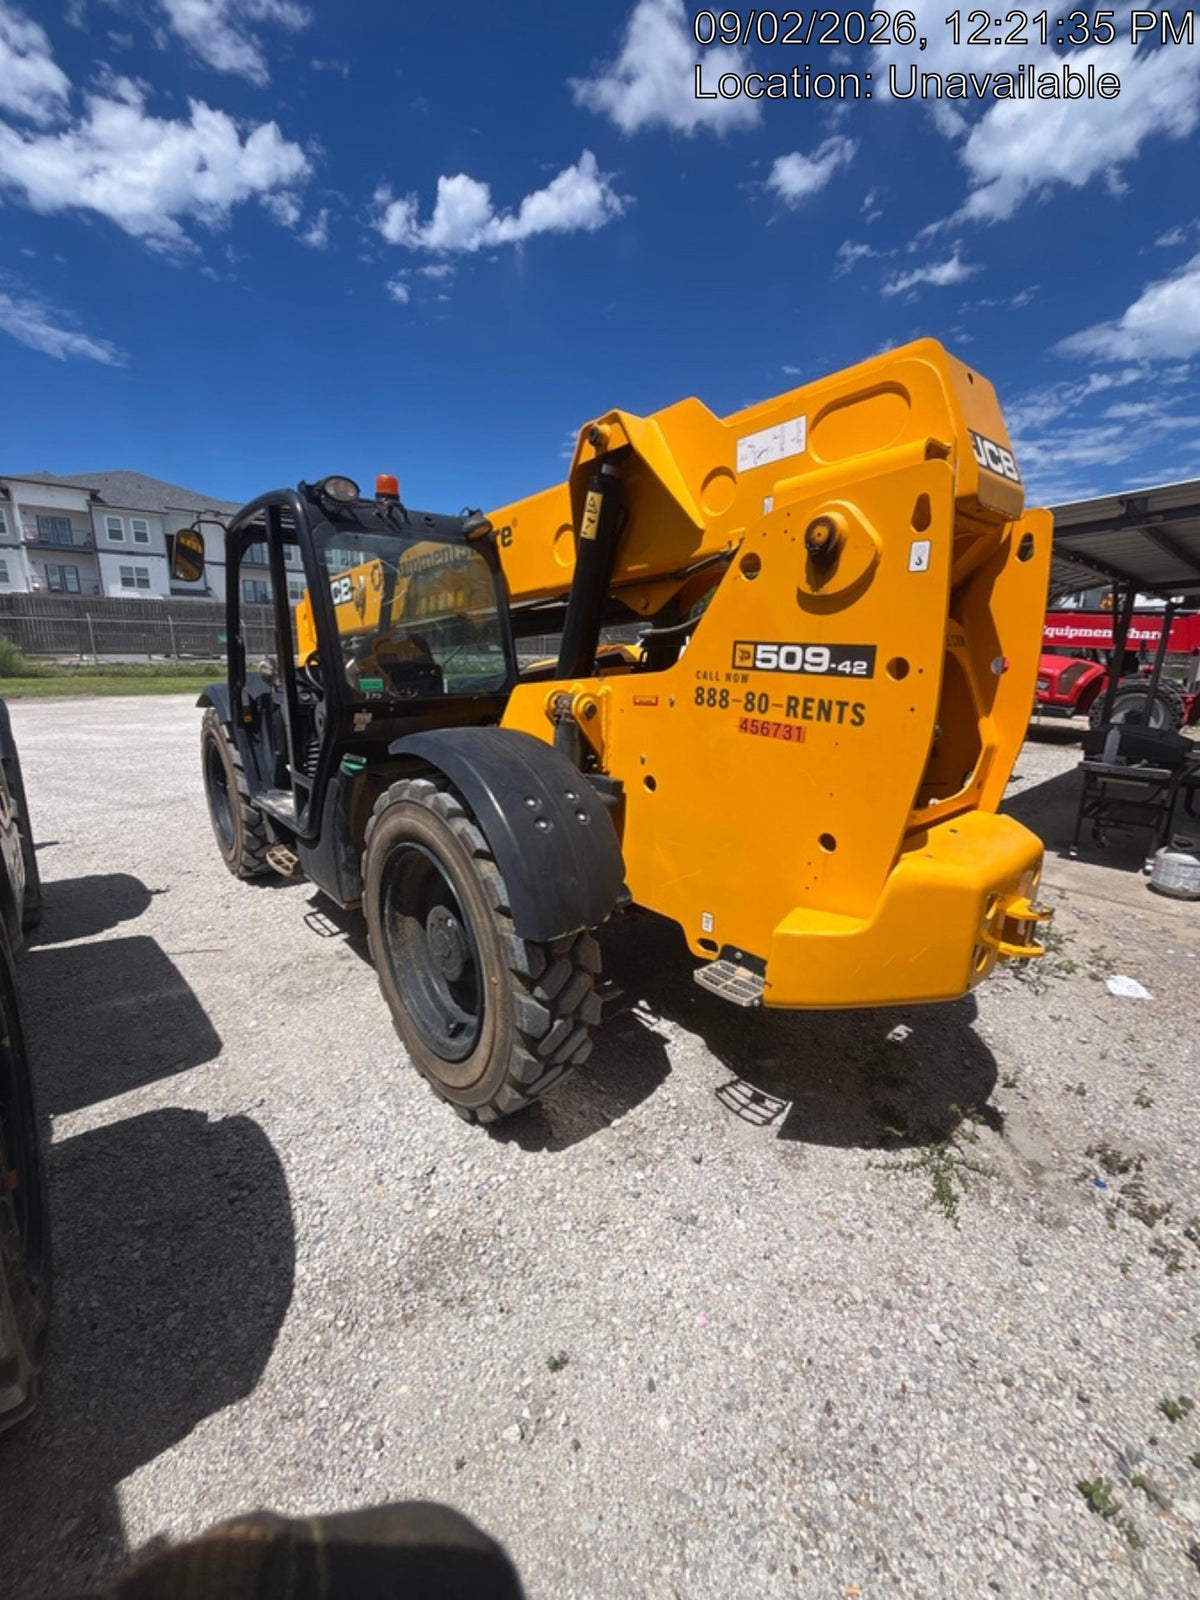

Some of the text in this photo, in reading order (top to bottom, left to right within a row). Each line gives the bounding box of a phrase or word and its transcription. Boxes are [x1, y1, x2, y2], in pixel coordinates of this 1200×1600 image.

[972, 434, 1019, 482] JCB
[329, 576, 353, 606] CB
[695, 670, 750, 684] CALL NOW
[694, 686, 867, 727] 888-80-RENTS
[738, 717, 804, 743] 456731
